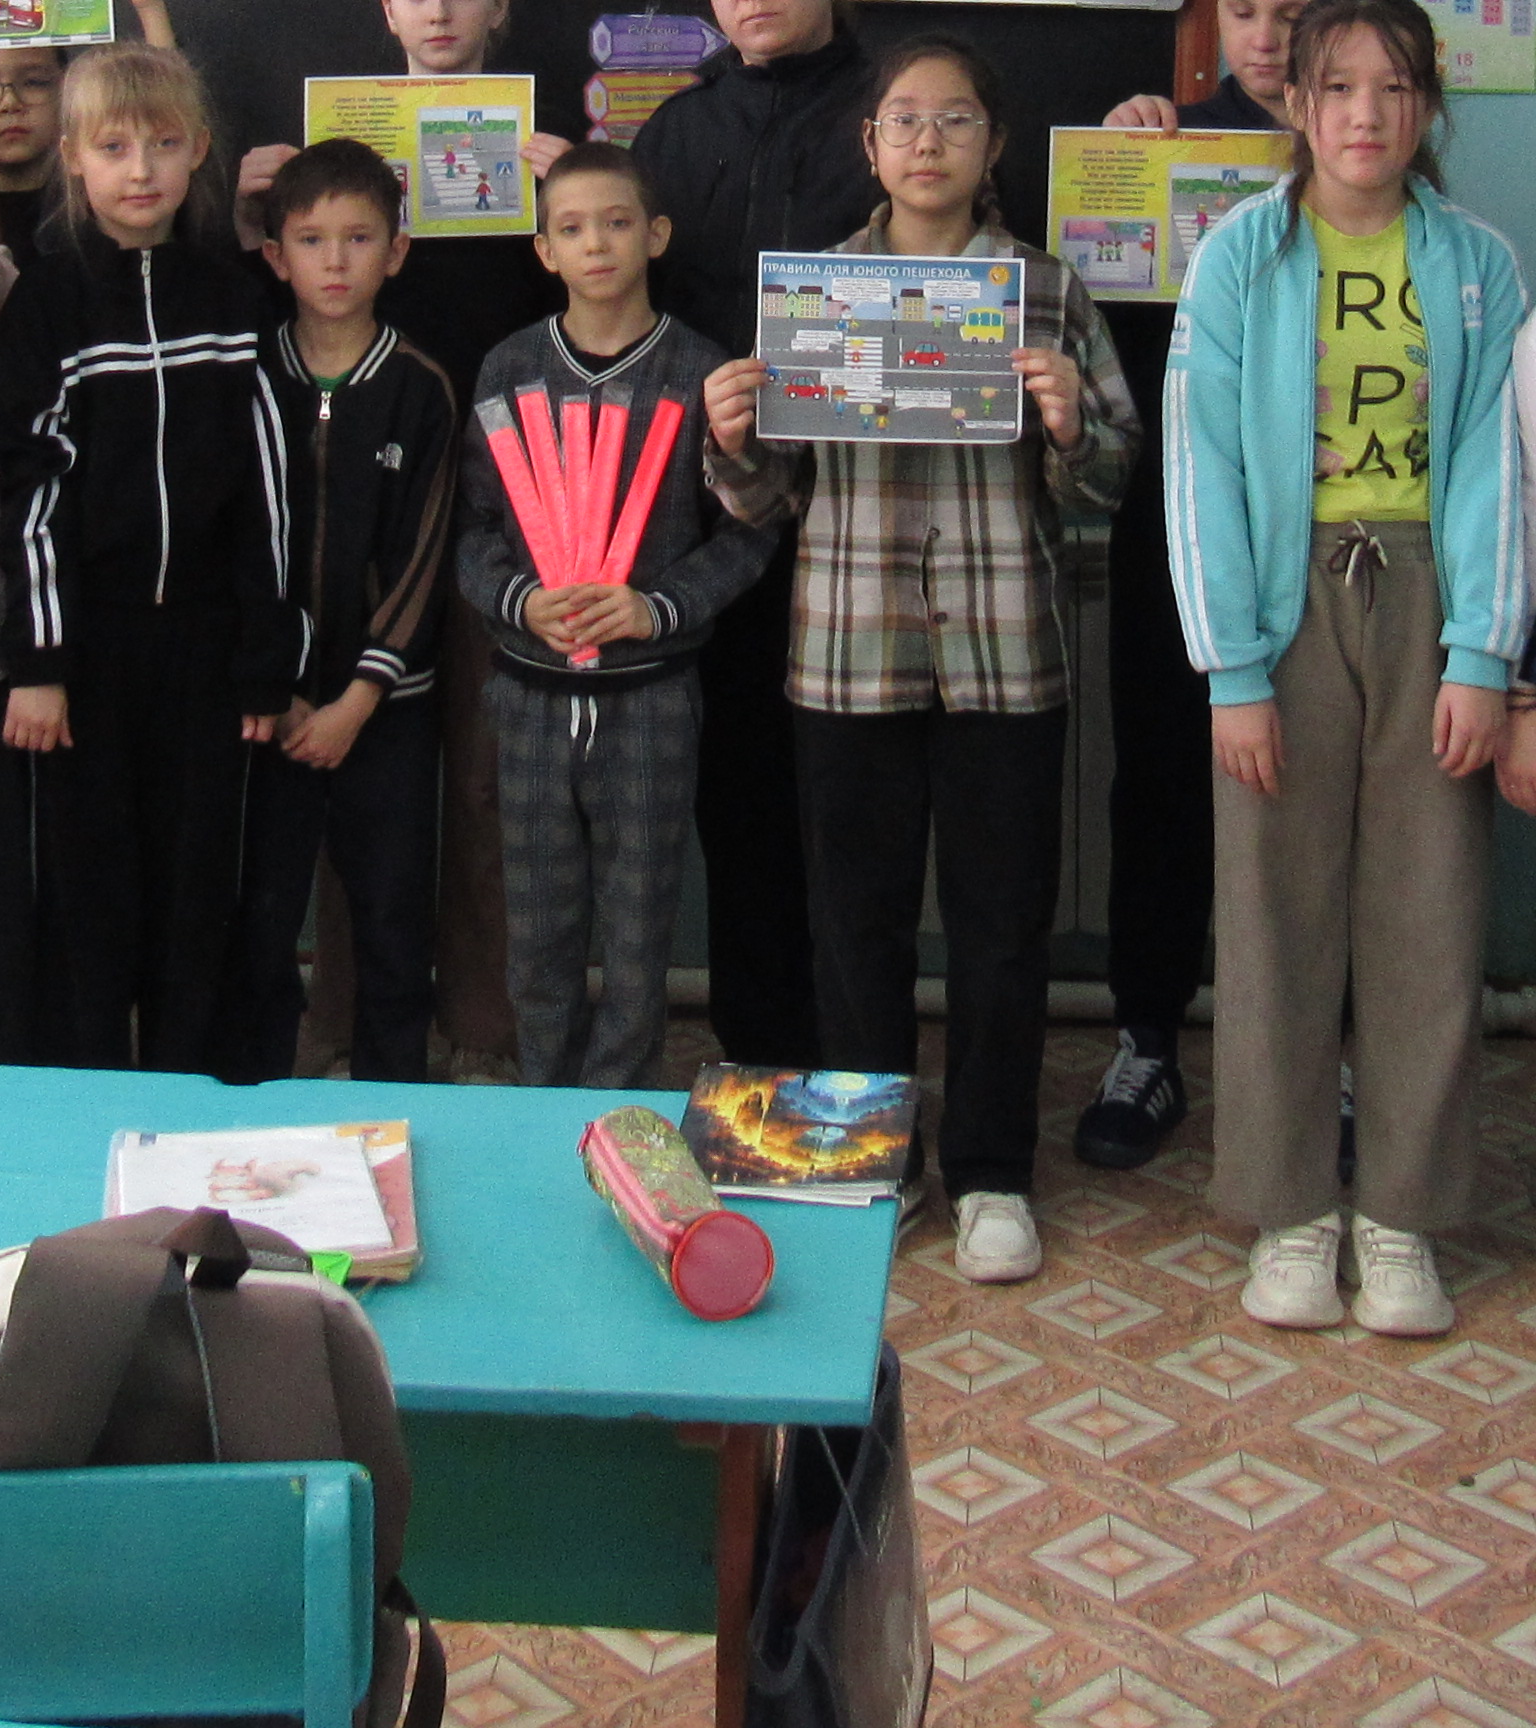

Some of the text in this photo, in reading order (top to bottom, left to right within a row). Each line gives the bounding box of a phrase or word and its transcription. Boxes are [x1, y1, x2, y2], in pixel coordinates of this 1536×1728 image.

[1458, 53, 1473, 66] 18
[764, 262, 972, 279] ПРАВИЛА ДЛЯ ЮНОГО ПЕШЕХОДА
